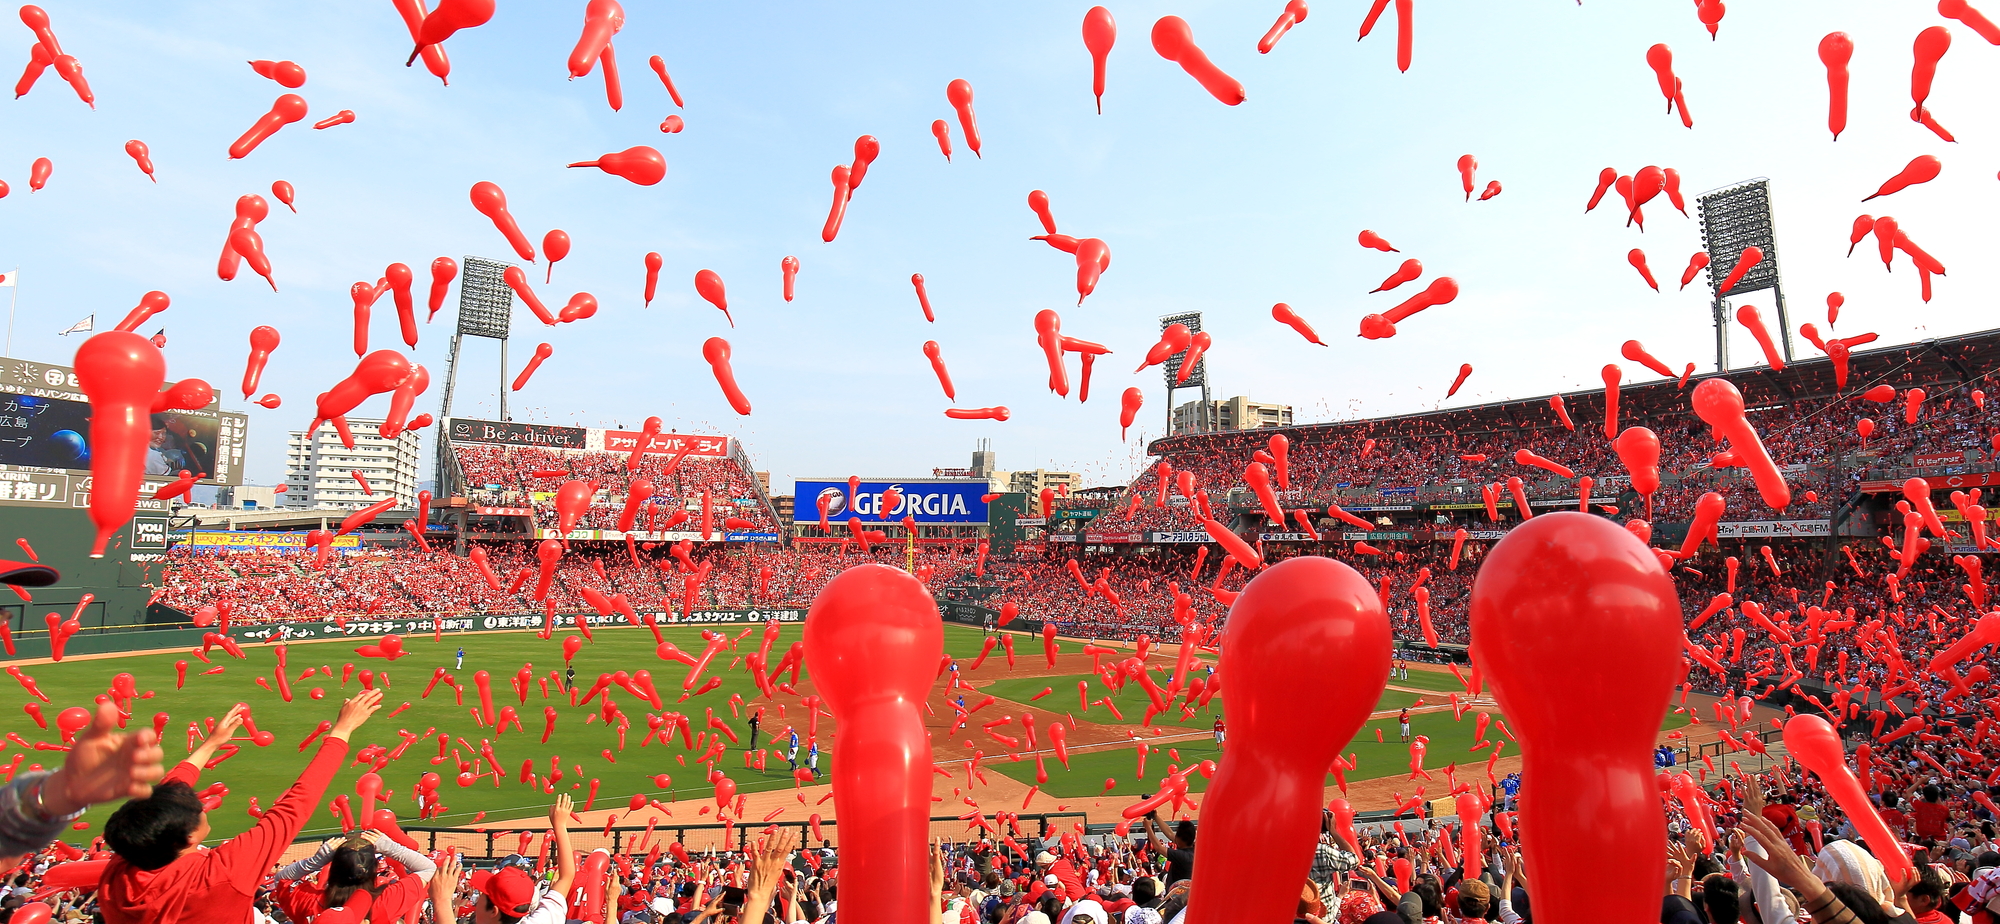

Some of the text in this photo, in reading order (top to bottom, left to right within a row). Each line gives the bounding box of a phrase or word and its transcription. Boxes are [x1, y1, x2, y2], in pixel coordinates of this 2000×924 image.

[31, 388, 89, 403] JAバンク広島
[4, 400, 49, 415] カープ
[0, 415, 28, 429] 広島
[484, 425, 575, 445] Be a driver.
[232, 418, 246, 466] シシンヨー
[216, 417, 232, 484] 広島市信用組合
[19, 466, 67, 475] NTTデータ中国
[137, 523, 163, 535] you
[1741, 525, 1769, 534] 広島FM
[141, 534, 164, 543] me
[230, 535, 274, 543] エディオン
[130, 554, 167, 562] ゆめタウン
[497, 616, 542, 628] 東洋証券
[566, 615, 613, 624] SZUKI
[762, 611, 799, 621] 五洋建設
[345, 622, 401, 634] フマキラー
[418, 619, 473, 631] 中国新聞
